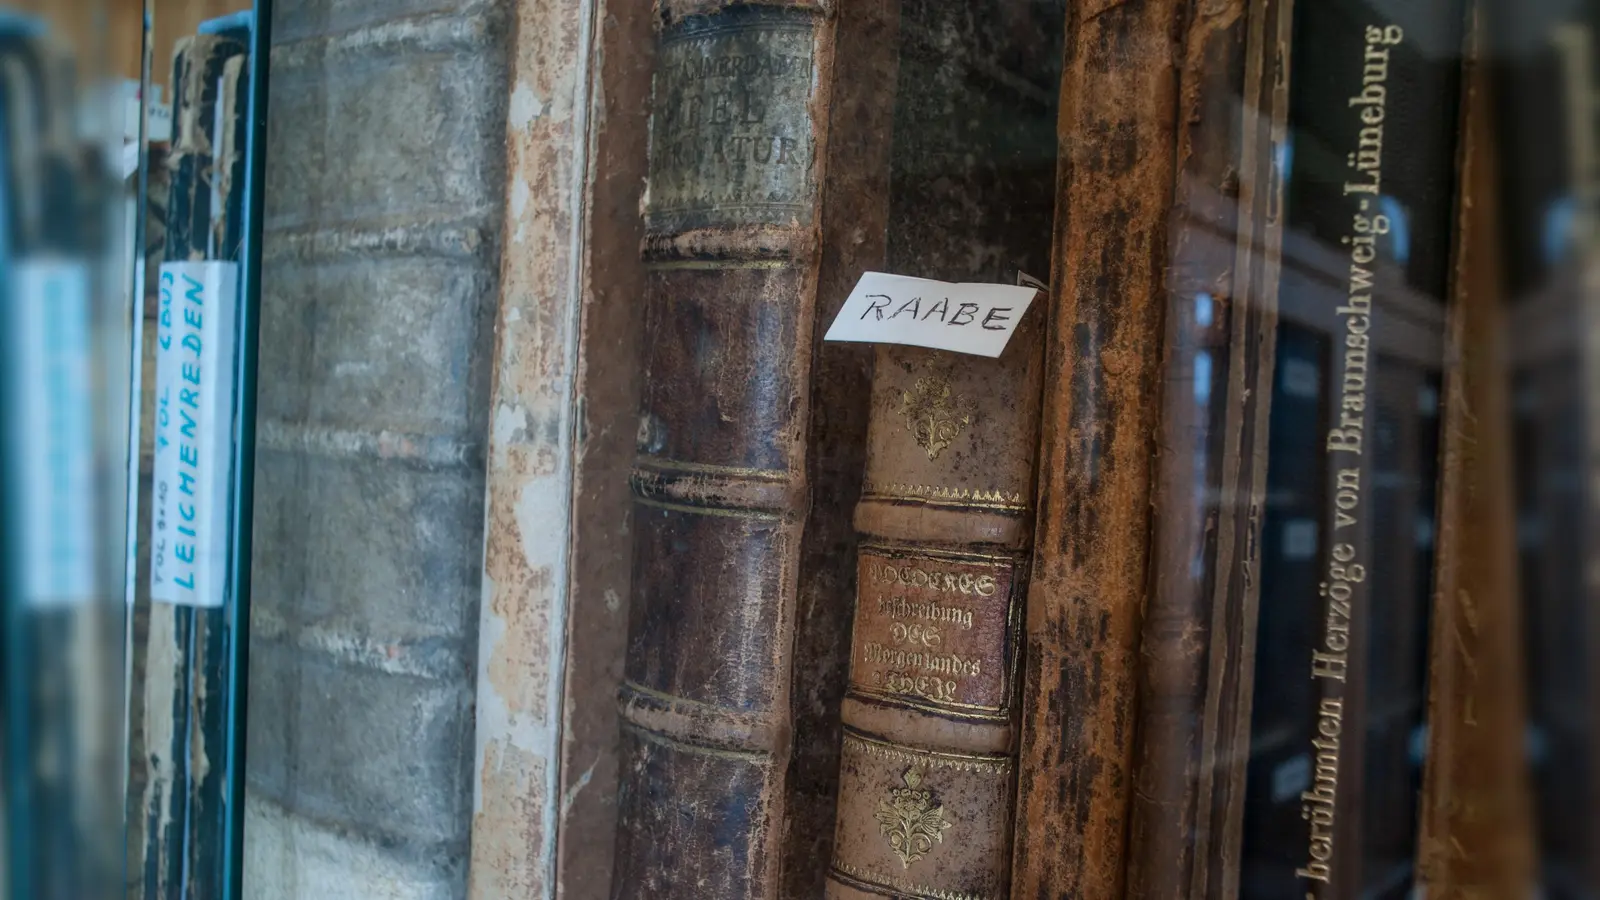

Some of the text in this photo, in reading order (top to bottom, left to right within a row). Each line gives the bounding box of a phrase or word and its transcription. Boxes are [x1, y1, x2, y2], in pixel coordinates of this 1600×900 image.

[173, 272, 205, 591] LEICHENREDEN
[860, 294, 1014, 331] RAABE
[1295, 24, 1403, 884] berühmten Herzöge von Braunschweig-Lüneburg
